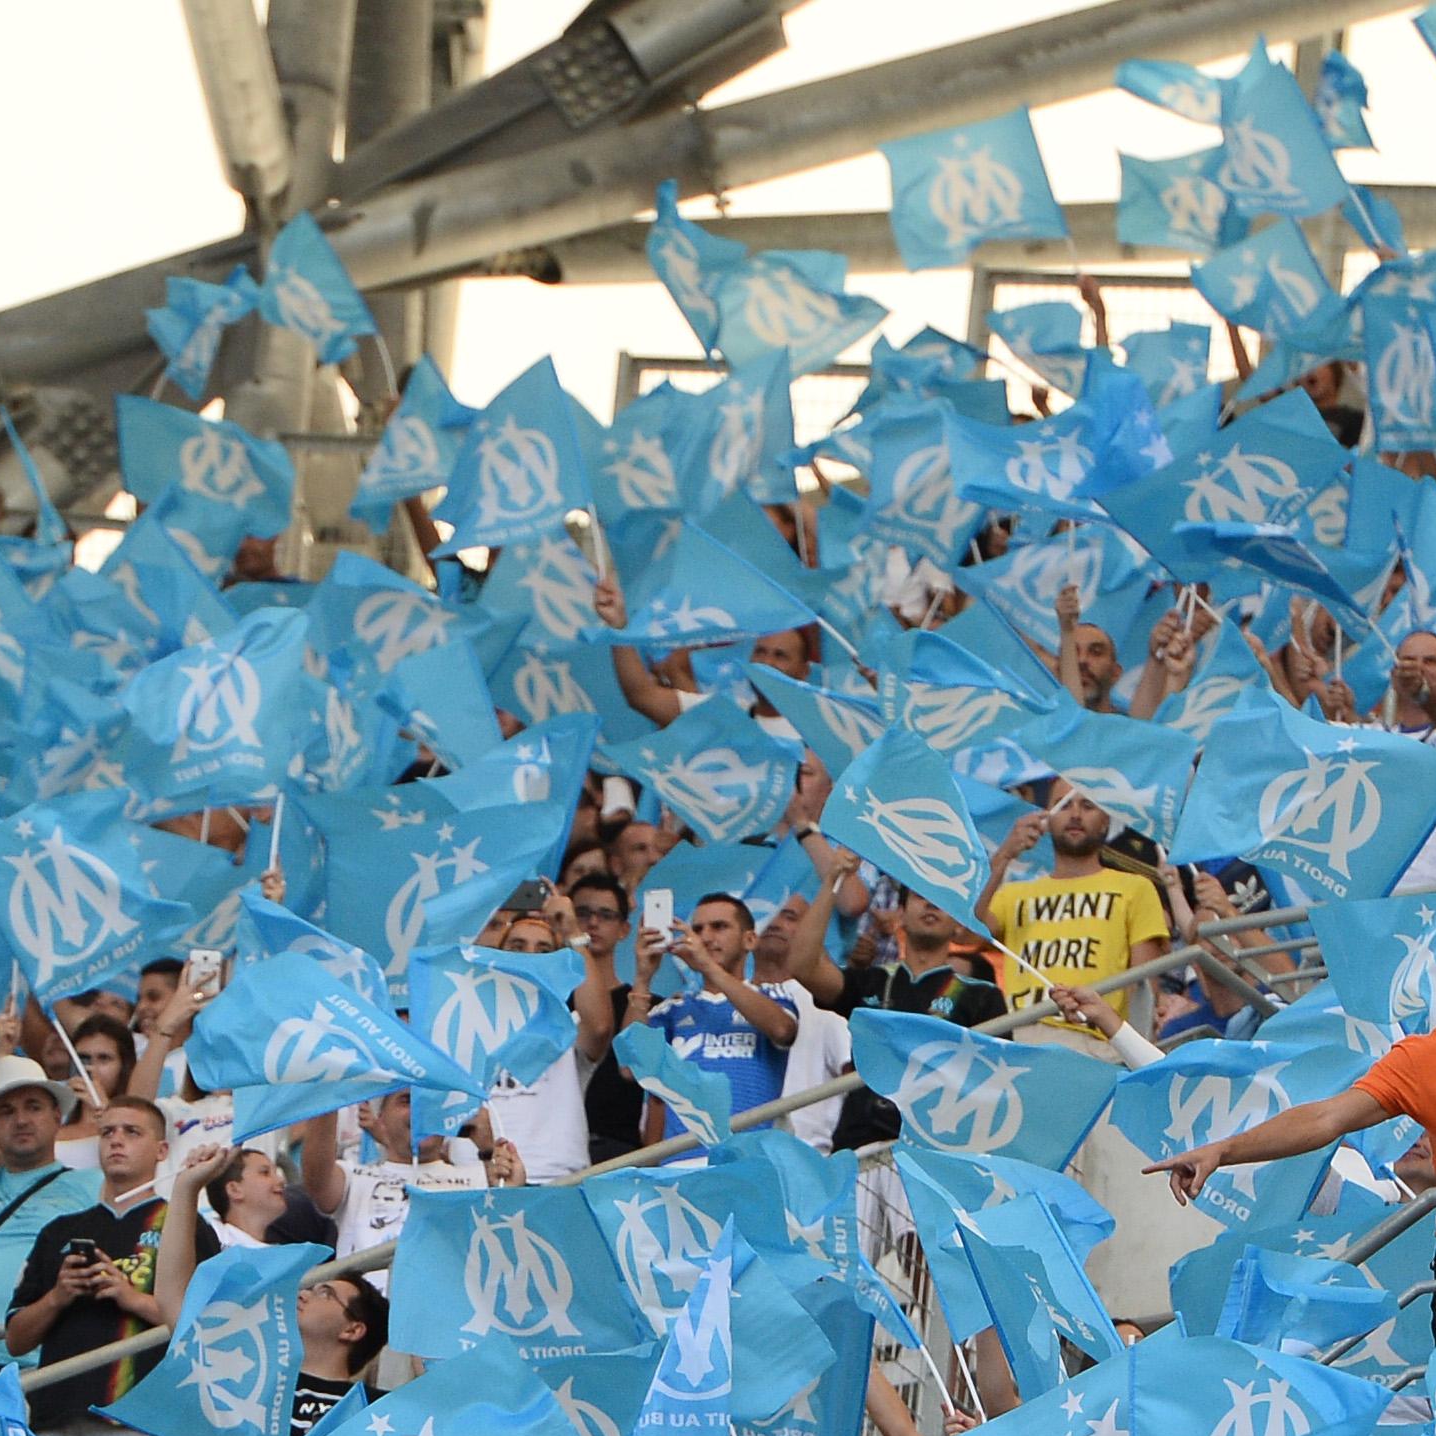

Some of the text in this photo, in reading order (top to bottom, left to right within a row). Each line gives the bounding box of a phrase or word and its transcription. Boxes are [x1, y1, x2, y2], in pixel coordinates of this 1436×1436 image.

[1015, 892, 1122, 927] I WANT
[1019, 938, 1101, 972] MORE
[704, 1032, 757, 1046] INTER
[702, 1047, 756, 1060] SPORT
